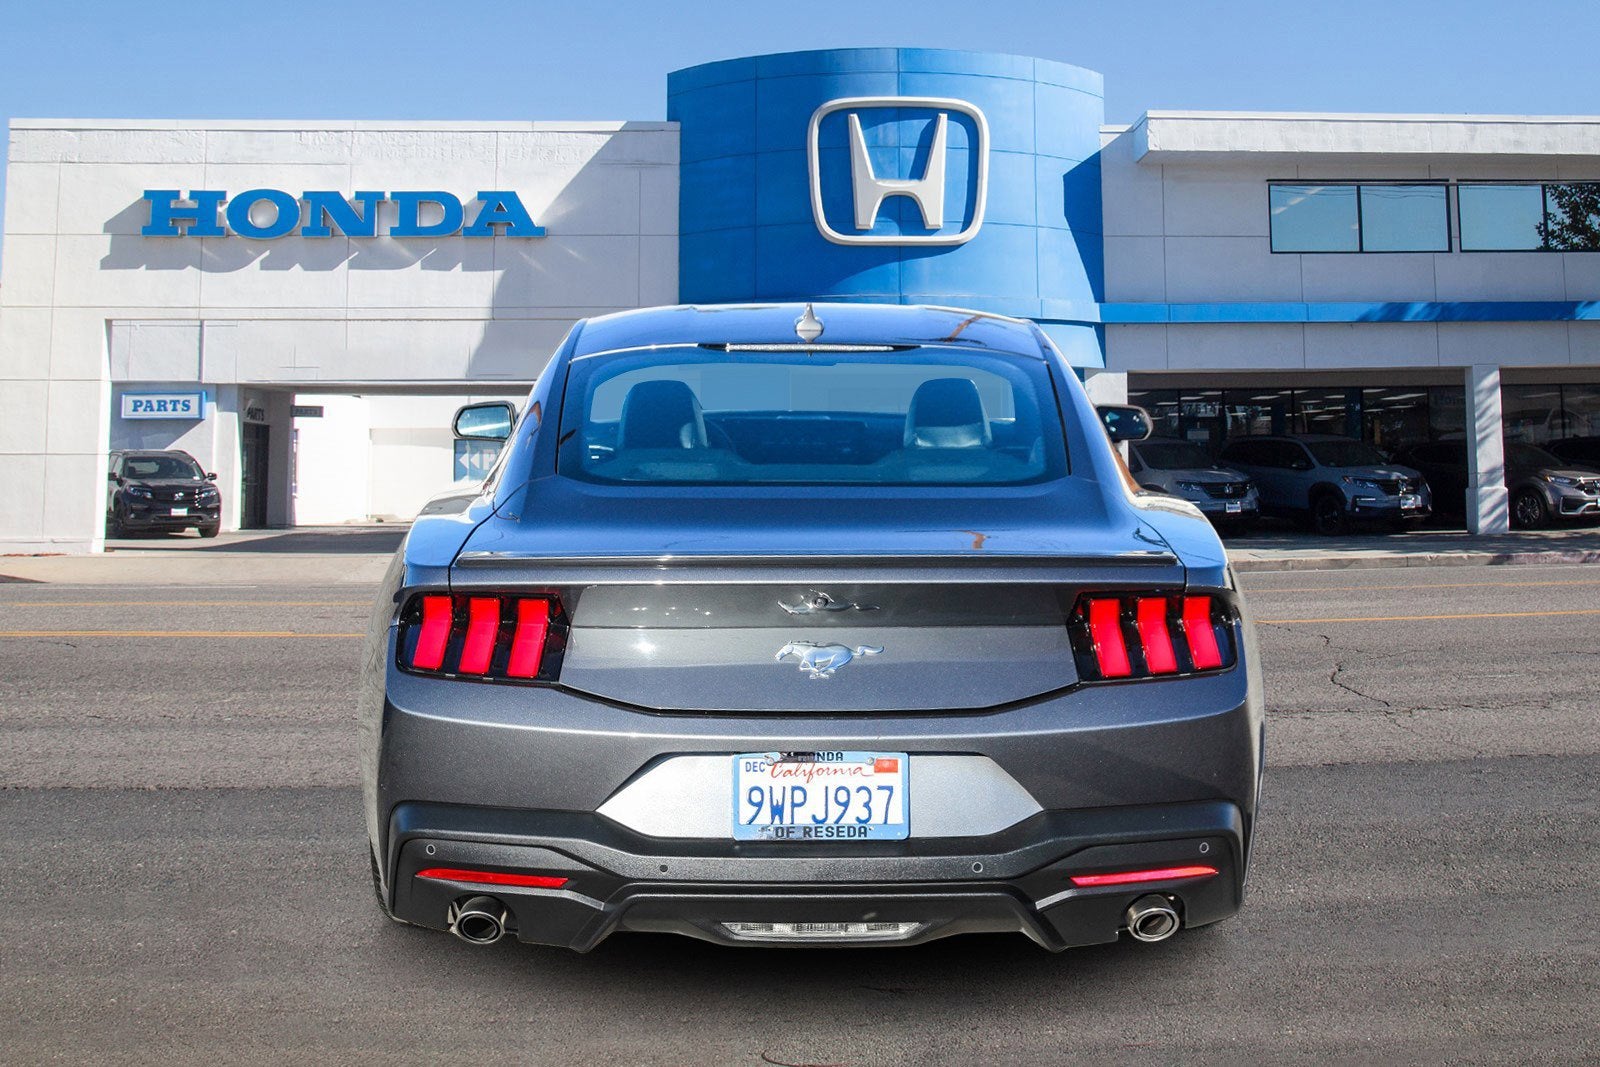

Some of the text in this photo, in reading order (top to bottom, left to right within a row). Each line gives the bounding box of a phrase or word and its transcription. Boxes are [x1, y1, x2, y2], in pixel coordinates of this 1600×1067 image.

[141, 189, 547, 239] HONDA
[132, 399, 191, 413] PARTS
[745, 761, 766, 773] DEC
[770, 762, 875, 783] California
[746, 785, 894, 825] 9WPJ937
[774, 826, 868, 838] OF RESEDA
